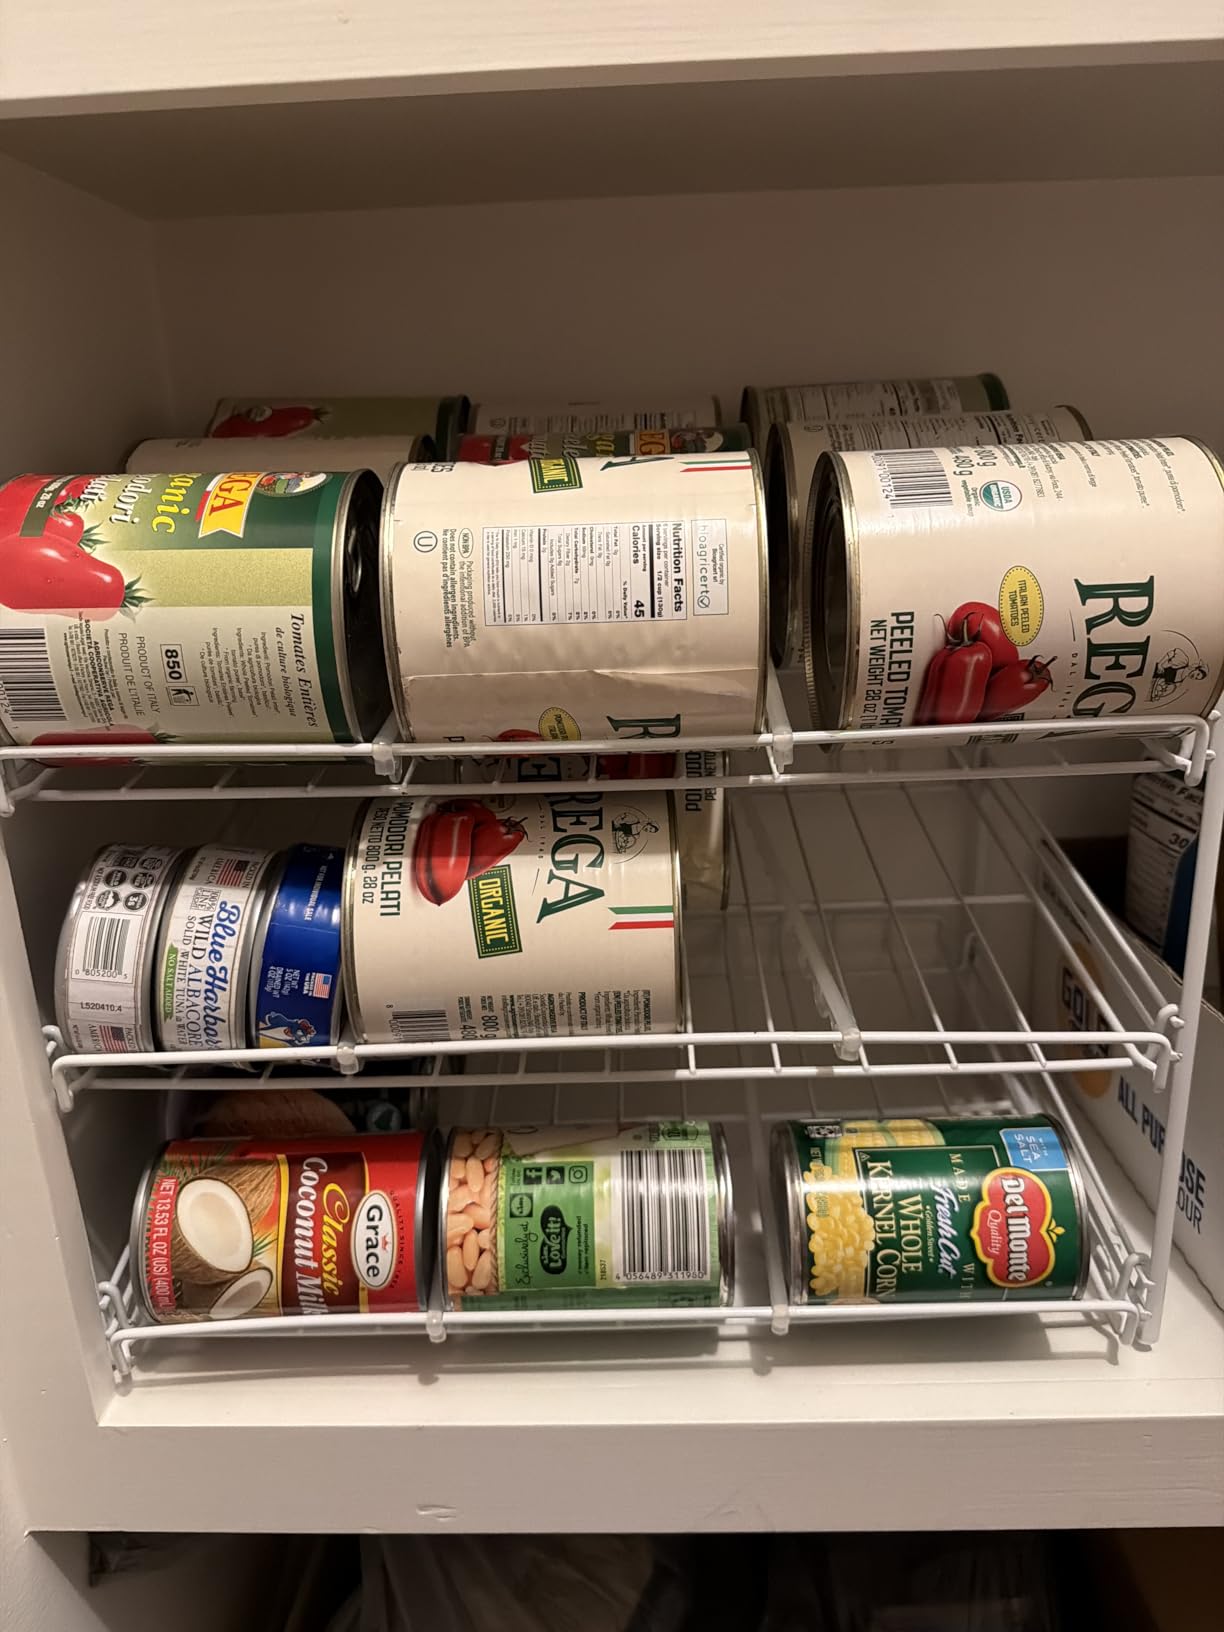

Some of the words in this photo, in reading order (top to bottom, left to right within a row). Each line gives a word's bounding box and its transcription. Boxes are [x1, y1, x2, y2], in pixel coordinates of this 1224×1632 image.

[879, 473, 893, 499] 00124
[1000, 486, 1012, 504] USDA
[442, 537, 450, 561] contient
[632, 525, 641, 565] Calories
[672, 523, 684, 574] Nutrition
[440, 561, 449, 572] pas
[467, 561, 475, 589] Packaging
[449, 576, 458, 603] allergen
[467, 590, 475, 618] produced
[674, 577, 684, 612] Facts
[1017, 579, 1028, 607] ITALIAN
[451, 604, 459, 641] ingredients.
[634, 599, 645, 618] 45
[1008, 590, 1019, 627] TOMATOES
[1020, 607, 1030, 634] PEELED
[275, 627, 285, 638] de
[291, 613, 307, 673] Tomates
[870, 619, 887, 642] NET
[118, 632, 133, 673] PRODUIT
[136, 636, 152, 679] PRODUCT
[277, 641, 288, 673] culture
[887, 611, 915, 684] PEELED
[1072, 575, 1154, 717] REG
[93, 640, 111, 693] AGRICONSERVE
[104, 694, 115, 711] REGA
[164, 648, 182, 680] 850
[866, 644, 886, 687] WEIGHT
[88, 651, 103, 697] COOPERATIVA
[99, 698, 115, 727] AGRICOLA
[124, 674, 135, 685] DE
[144, 680, 155, 691] OF
[128, 688, 145, 716] L'ITALIE
[148, 693, 160, 713] ITALY
[281, 675, 297, 717] biologique
[298, 677, 319, 728] Entières
[865, 689, 882, 701] 28
[368, 821, 386, 843] NETTO
[384, 802, 414, 856] POMODORI
[365, 845, 380, 862] 800
[363, 876, 378, 889] 28
[380, 861, 402, 917] PELATI
[304, 907, 314, 920] SALE
[479, 878, 509, 945] ORGANIC
[182, 915, 196, 946] SOLID
[191, 914, 214, 960] WILD
[208, 900, 241, 964] Blue
[85, 968, 118, 978] 805200
[168, 953, 176, 966] NO
[176, 950, 190, 983] WHITE
[292, 969, 301, 980] NET
[166, 968, 175, 986] SALT
[273, 967, 284, 990] DRAINED
[164, 988, 172, 1013] ADDED
[175, 987, 186, 1013] TUNA
[186, 964, 204, 1048] ALBACORE
[203, 965, 229, 1048] Harbor
[177, 1023, 188, 1045] WATER
[481, 1015, 499, 1032] 800
[1118, 1075, 1138, 1124] ALL
[1013, 1133, 1032, 1163] SALT
[1026, 1135, 1041, 1161] SEA
[160, 1179, 176, 1196] NET
[949, 1153, 971, 1203] MADE
[866, 1160, 897, 1246] KERNEL
[930, 1182, 960, 1239] Fresh
[1001, 1178, 1029, 1214] Del
[1177, 1186, 1202, 1234] OUR
[154, 1198, 171, 1226] 13.53
[294, 1157, 328, 1269] Coconut
[519, 1221, 529, 1232] at
[925, 1210, 934, 1237] Golden
[153, 1227, 168, 1239] FL
[322, 1182, 350, 1295] Classic
[366, 1204, 383, 1278] Grace
[897, 1194, 924, 1274] WHOLE
[926, 1237, 935, 1257] Sweet
[987, 1209, 1003, 1255] Quality
[152, 1241, 168, 1256] OZ
[514, 1232, 538, 1286] Exclusively
[938, 1237, 961, 1280] Cut
[1007, 1216, 1031, 1281] Monte
[151, 1257, 169, 1276] (US)
[625, 1272, 662, 1280] 056489
[876, 1248, 901, 1298] CORN
[154, 1277, 170, 1296] (400
[296, 1271, 329, 1314] Milk
